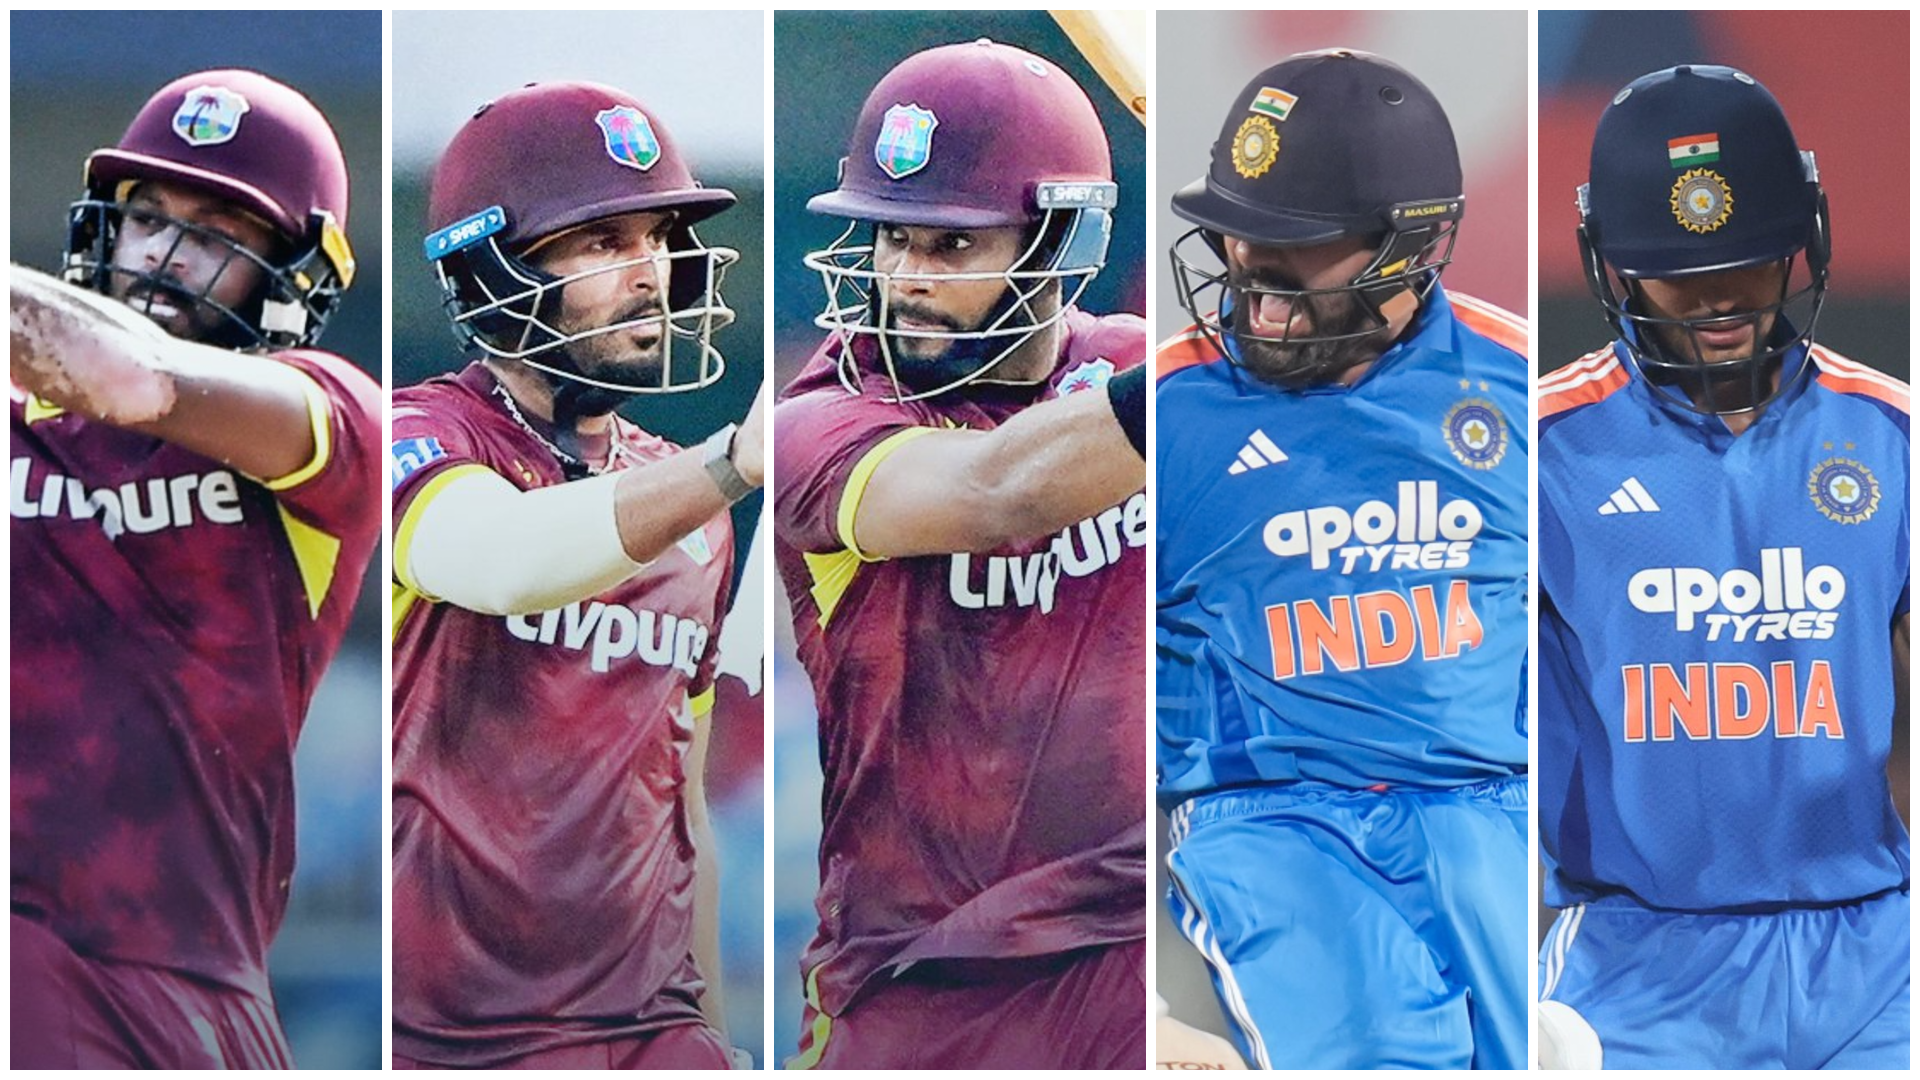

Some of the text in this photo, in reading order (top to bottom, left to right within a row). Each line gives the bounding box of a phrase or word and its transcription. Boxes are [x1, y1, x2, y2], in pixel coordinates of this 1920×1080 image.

[448, 216, 486, 245] SHREY
[1404, 204, 1448, 218] MASURI
[1263, 480, 1483, 570] apollo
[1339, 541, 1473, 574] TYRES
[1627, 546, 1846, 632] apollo
[1264, 580, 1484, 681] INDIA
[1704, 610, 1840, 643] TYRES
[1621, 659, 1845, 743] INDIA
